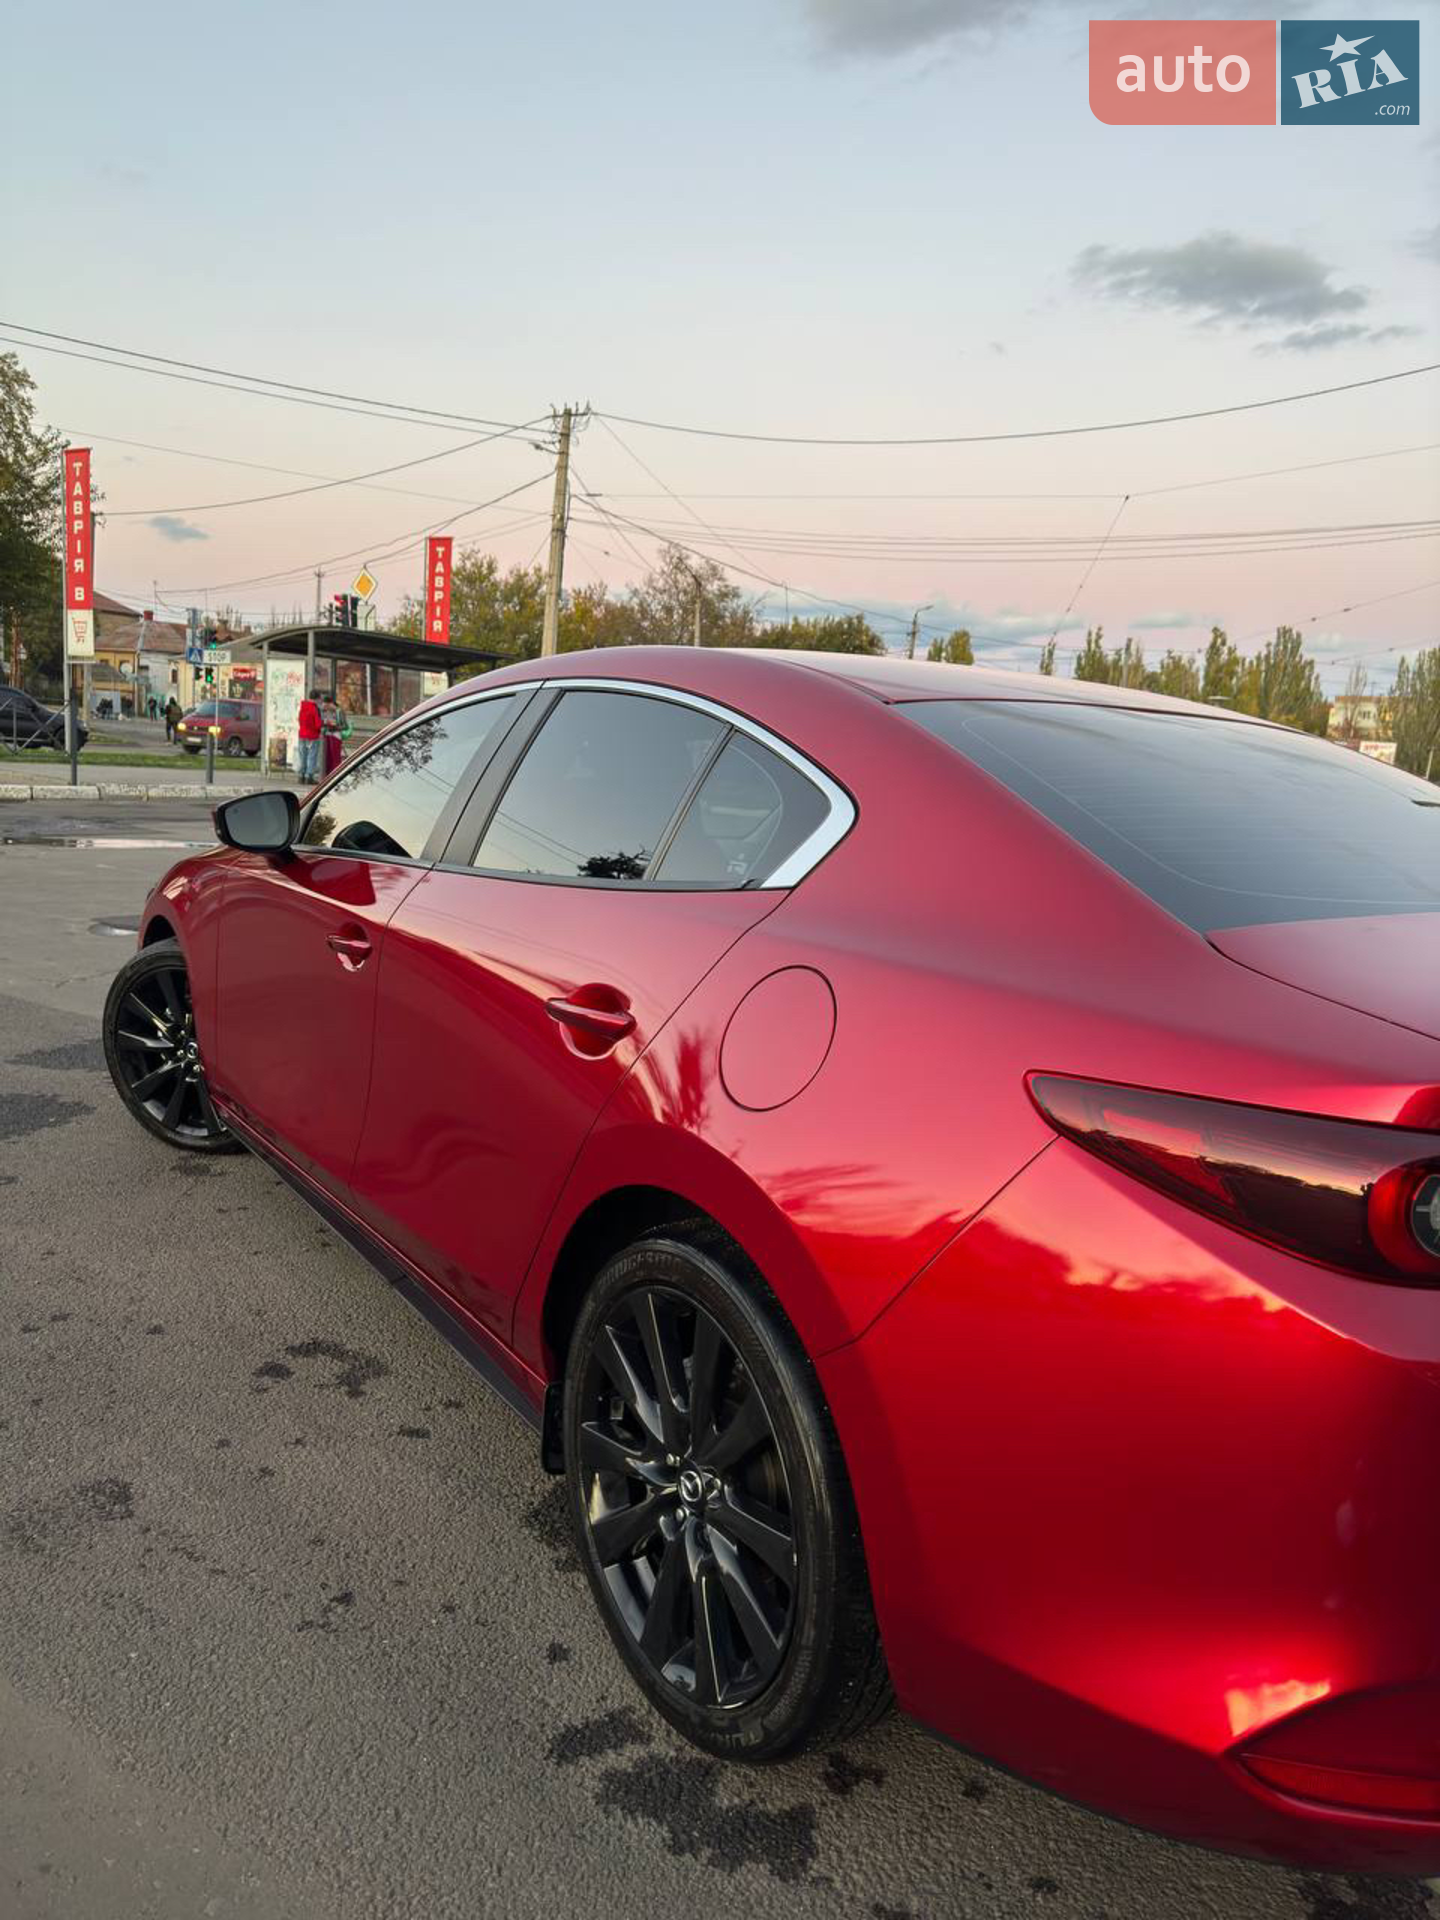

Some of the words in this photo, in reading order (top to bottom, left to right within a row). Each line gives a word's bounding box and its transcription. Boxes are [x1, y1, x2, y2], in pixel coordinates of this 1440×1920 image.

[73, 462, 84, 573] ТАВРІЯ
[75, 587, 84, 601] В
[433, 547, 445, 632] ТАВРІЯ
